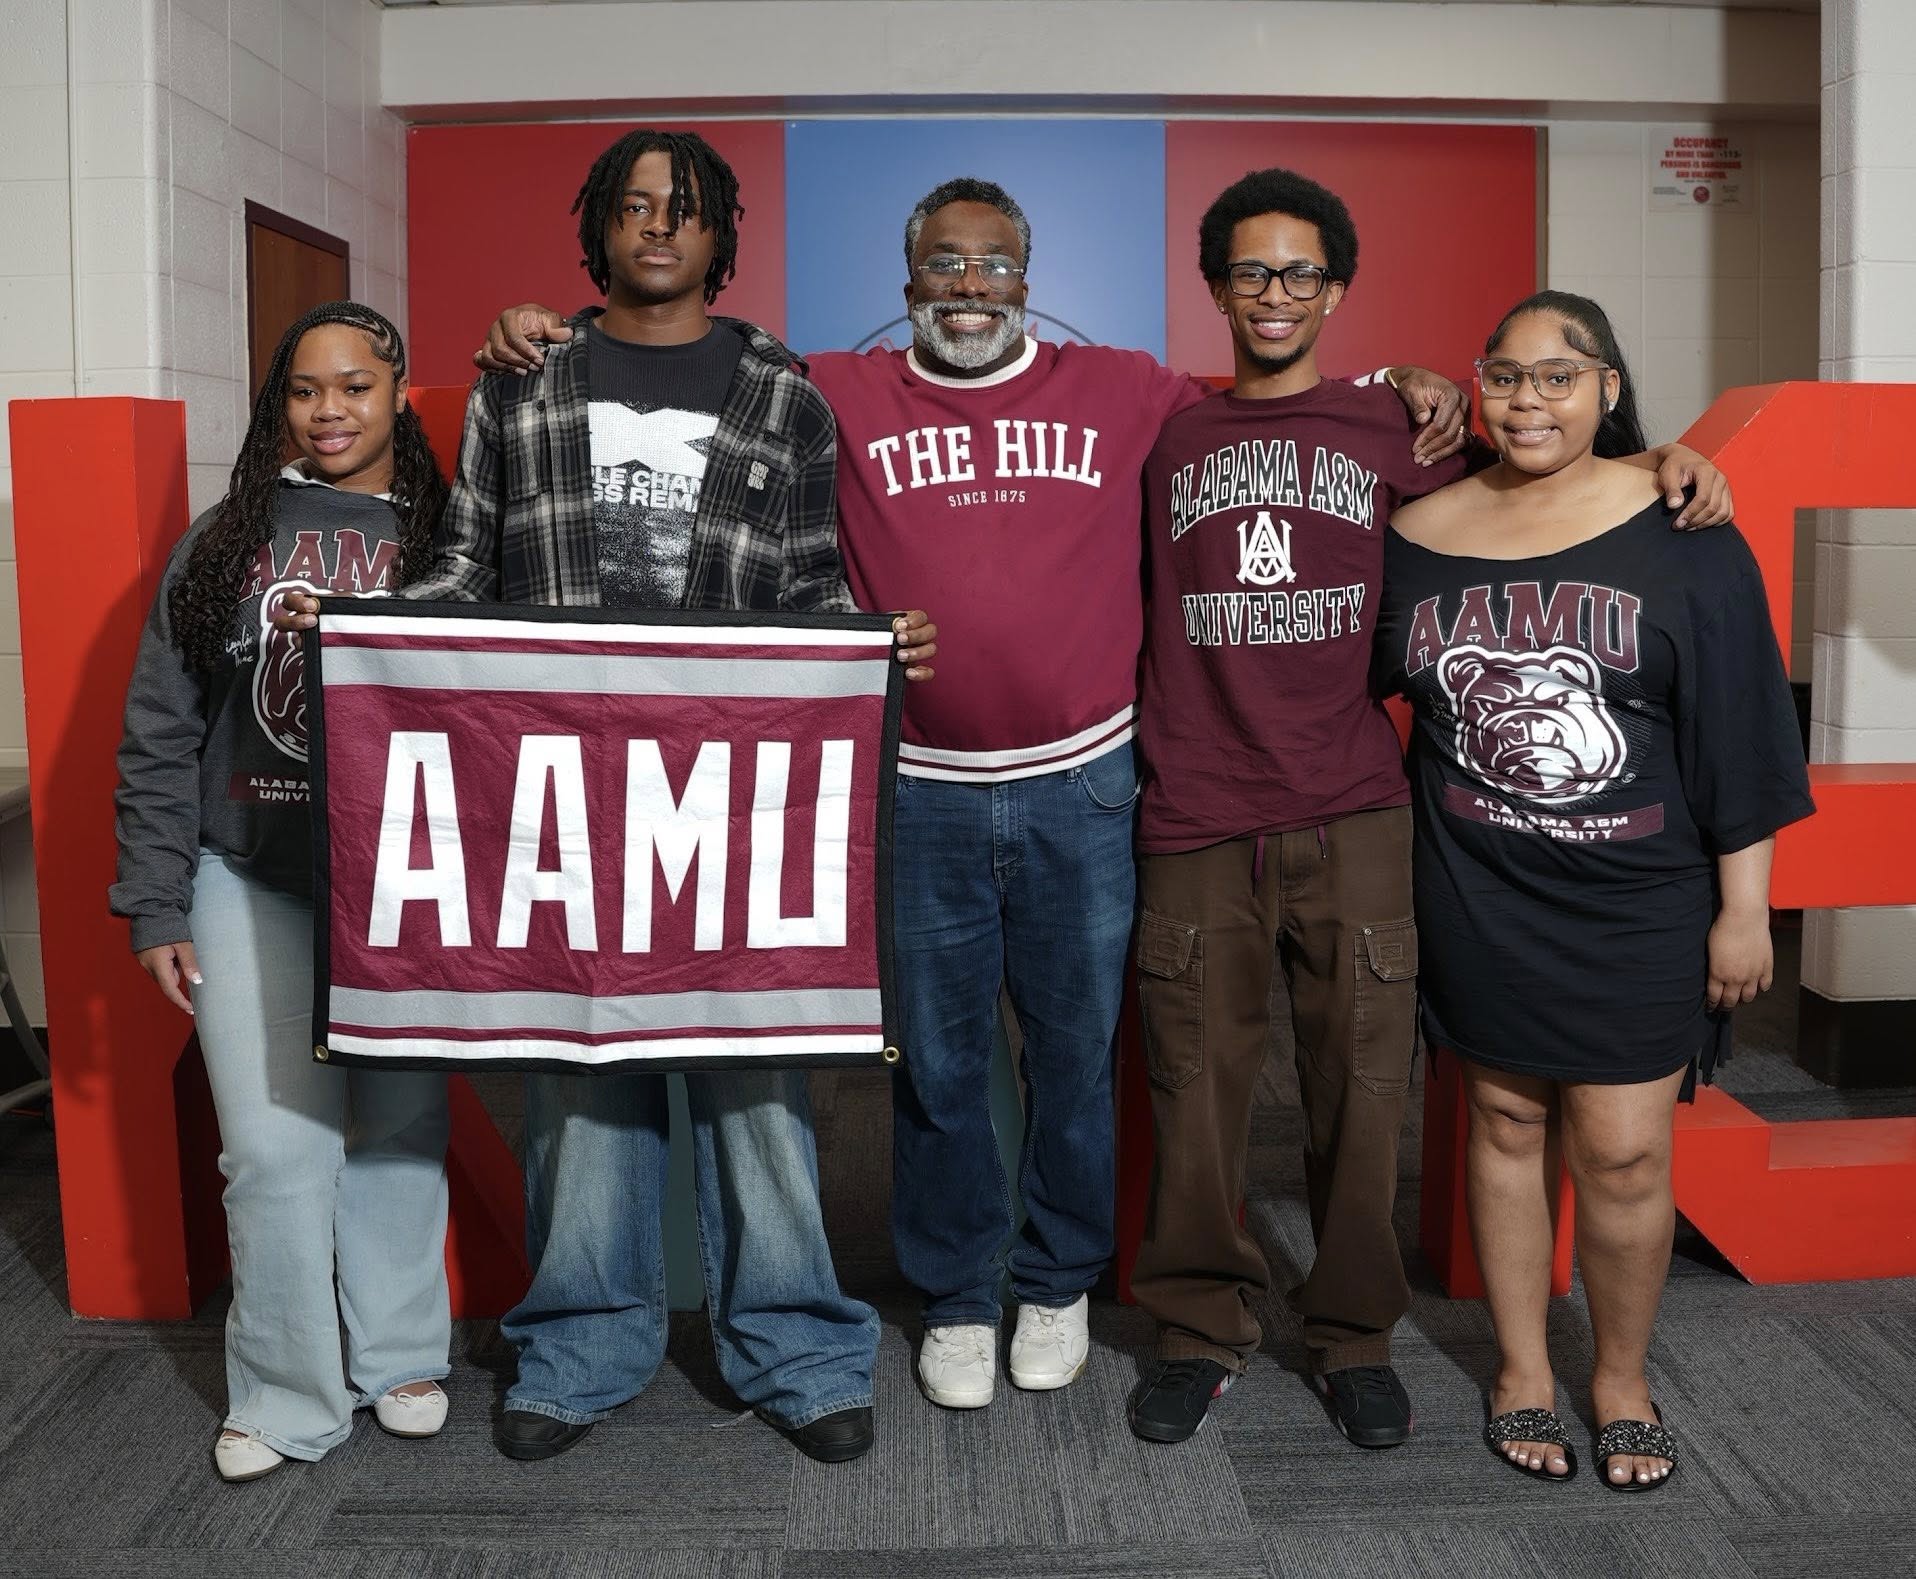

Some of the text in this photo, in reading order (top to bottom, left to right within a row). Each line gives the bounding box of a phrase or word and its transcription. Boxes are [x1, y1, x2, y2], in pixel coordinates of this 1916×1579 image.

[1673, 137, 1729, 148] OCCUPANCY
[1696, 150, 1714, 158] THAN
[1660, 160, 1691, 168] PERSONS
[591, 465, 627, 486] LE
[867, 419, 1102, 497] THE HILL
[948, 490, 1026, 507] SINCE 1875
[1171, 439, 1378, 542] ALABAMA A&M
[1182, 583, 1366, 646] UNIVERSITY
[1404, 581, 1641, 678] AAMU
[367, 731, 855, 953] AAMU
